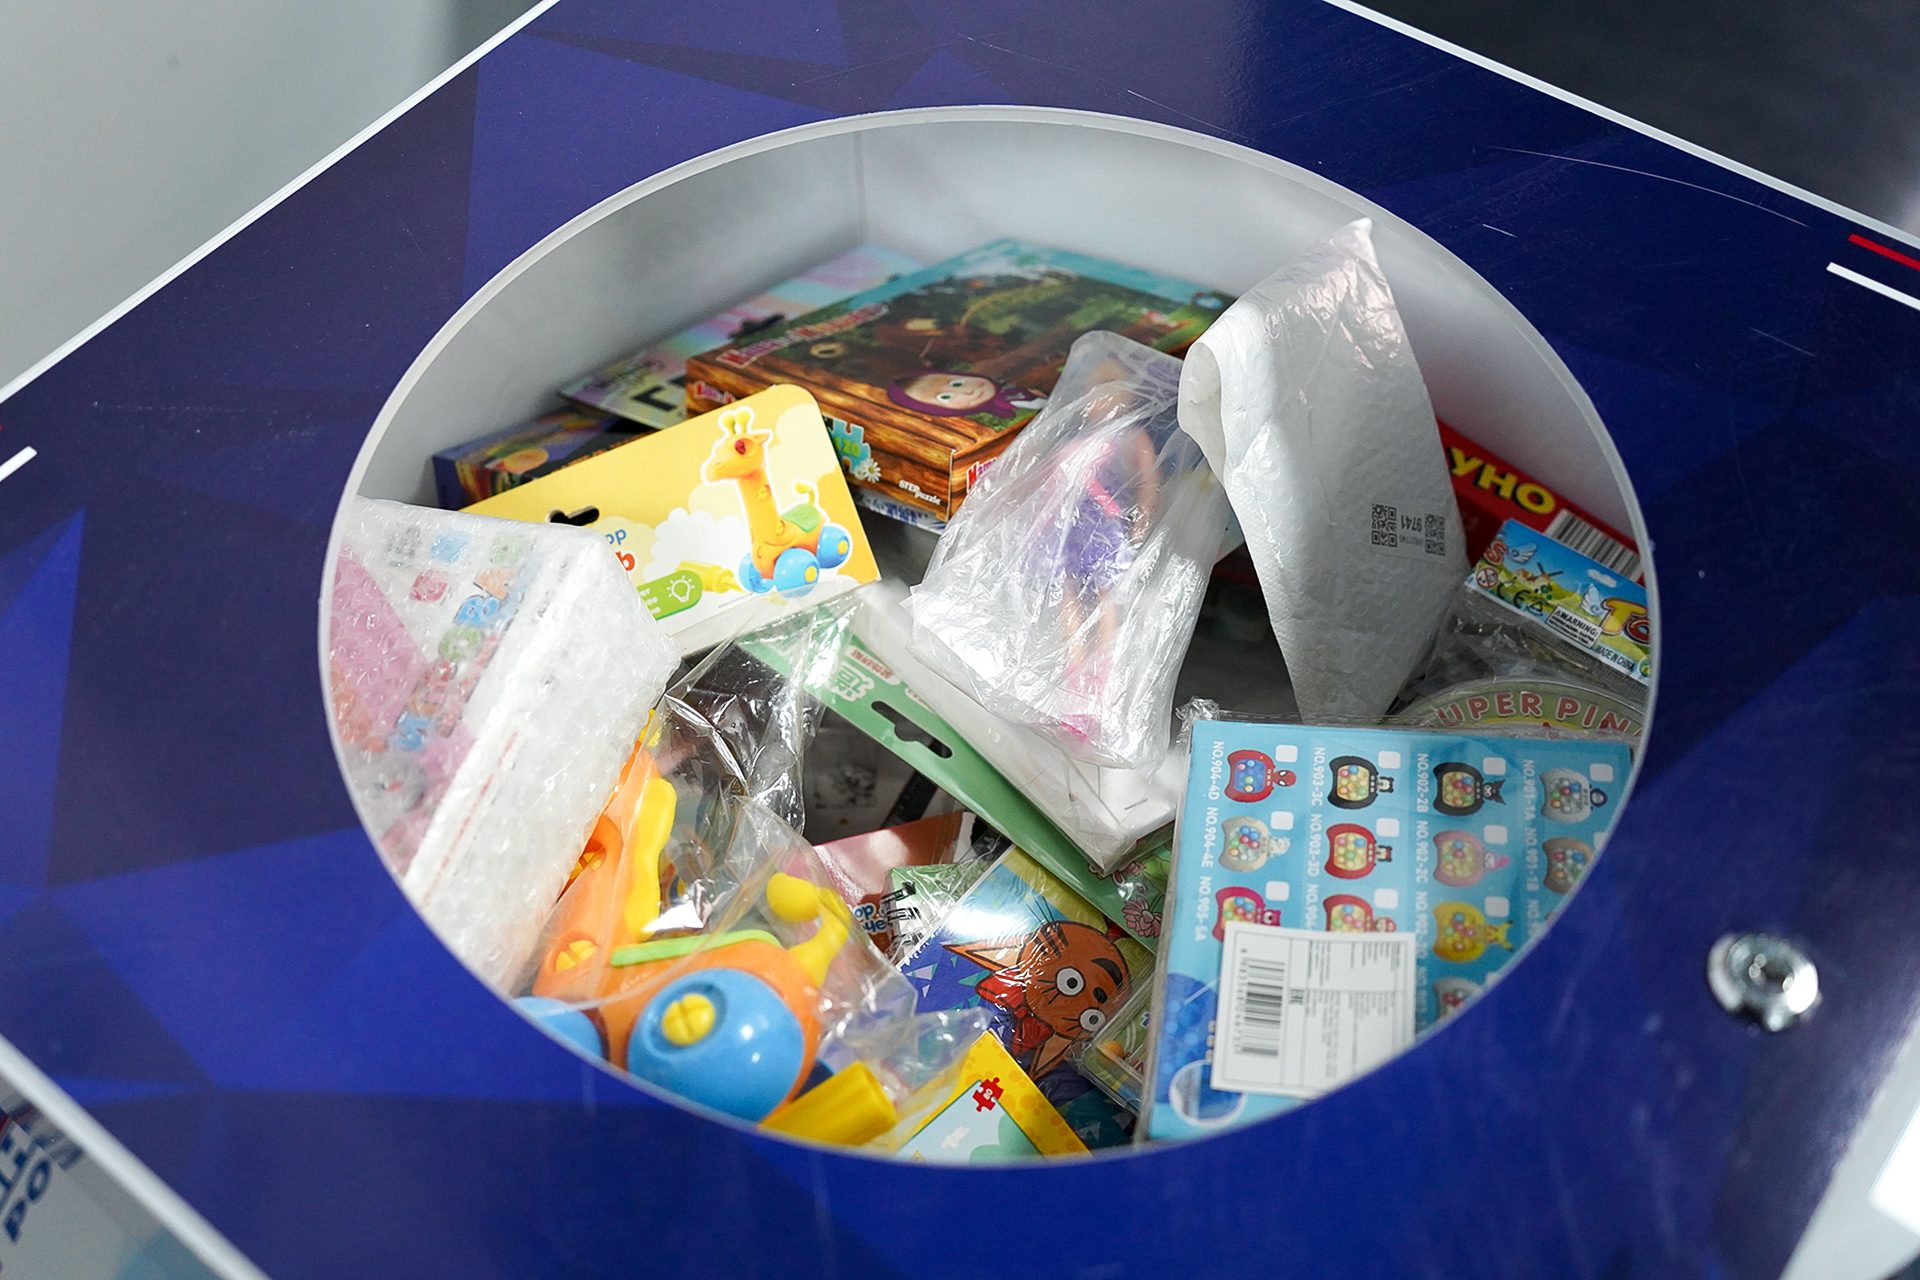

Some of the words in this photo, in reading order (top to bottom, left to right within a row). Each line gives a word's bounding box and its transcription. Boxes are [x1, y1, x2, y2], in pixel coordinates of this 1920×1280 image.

[913, 488, 942, 507] puzzle
[1400, 514, 1422, 533] 9741
[1560, 611, 1599, 637] WARNING:
[1617, 654, 1635, 672] CHINA
[1435, 690, 1542, 728] UPER
[1555, 696, 1640, 735] PIN
[1207, 740, 1224, 801] NO.904-4D
[1311, 746, 1325, 807] NO.903-3C
[1416, 752, 1429, 813] NO.902-2B
[1522, 759, 1536, 821] NO.901-1A
[1201, 807, 1218, 868] NO.904-4E
[1308, 813, 1322, 877] NO.903-3D
[1416, 820, 1429, 883] NO.902-2C
